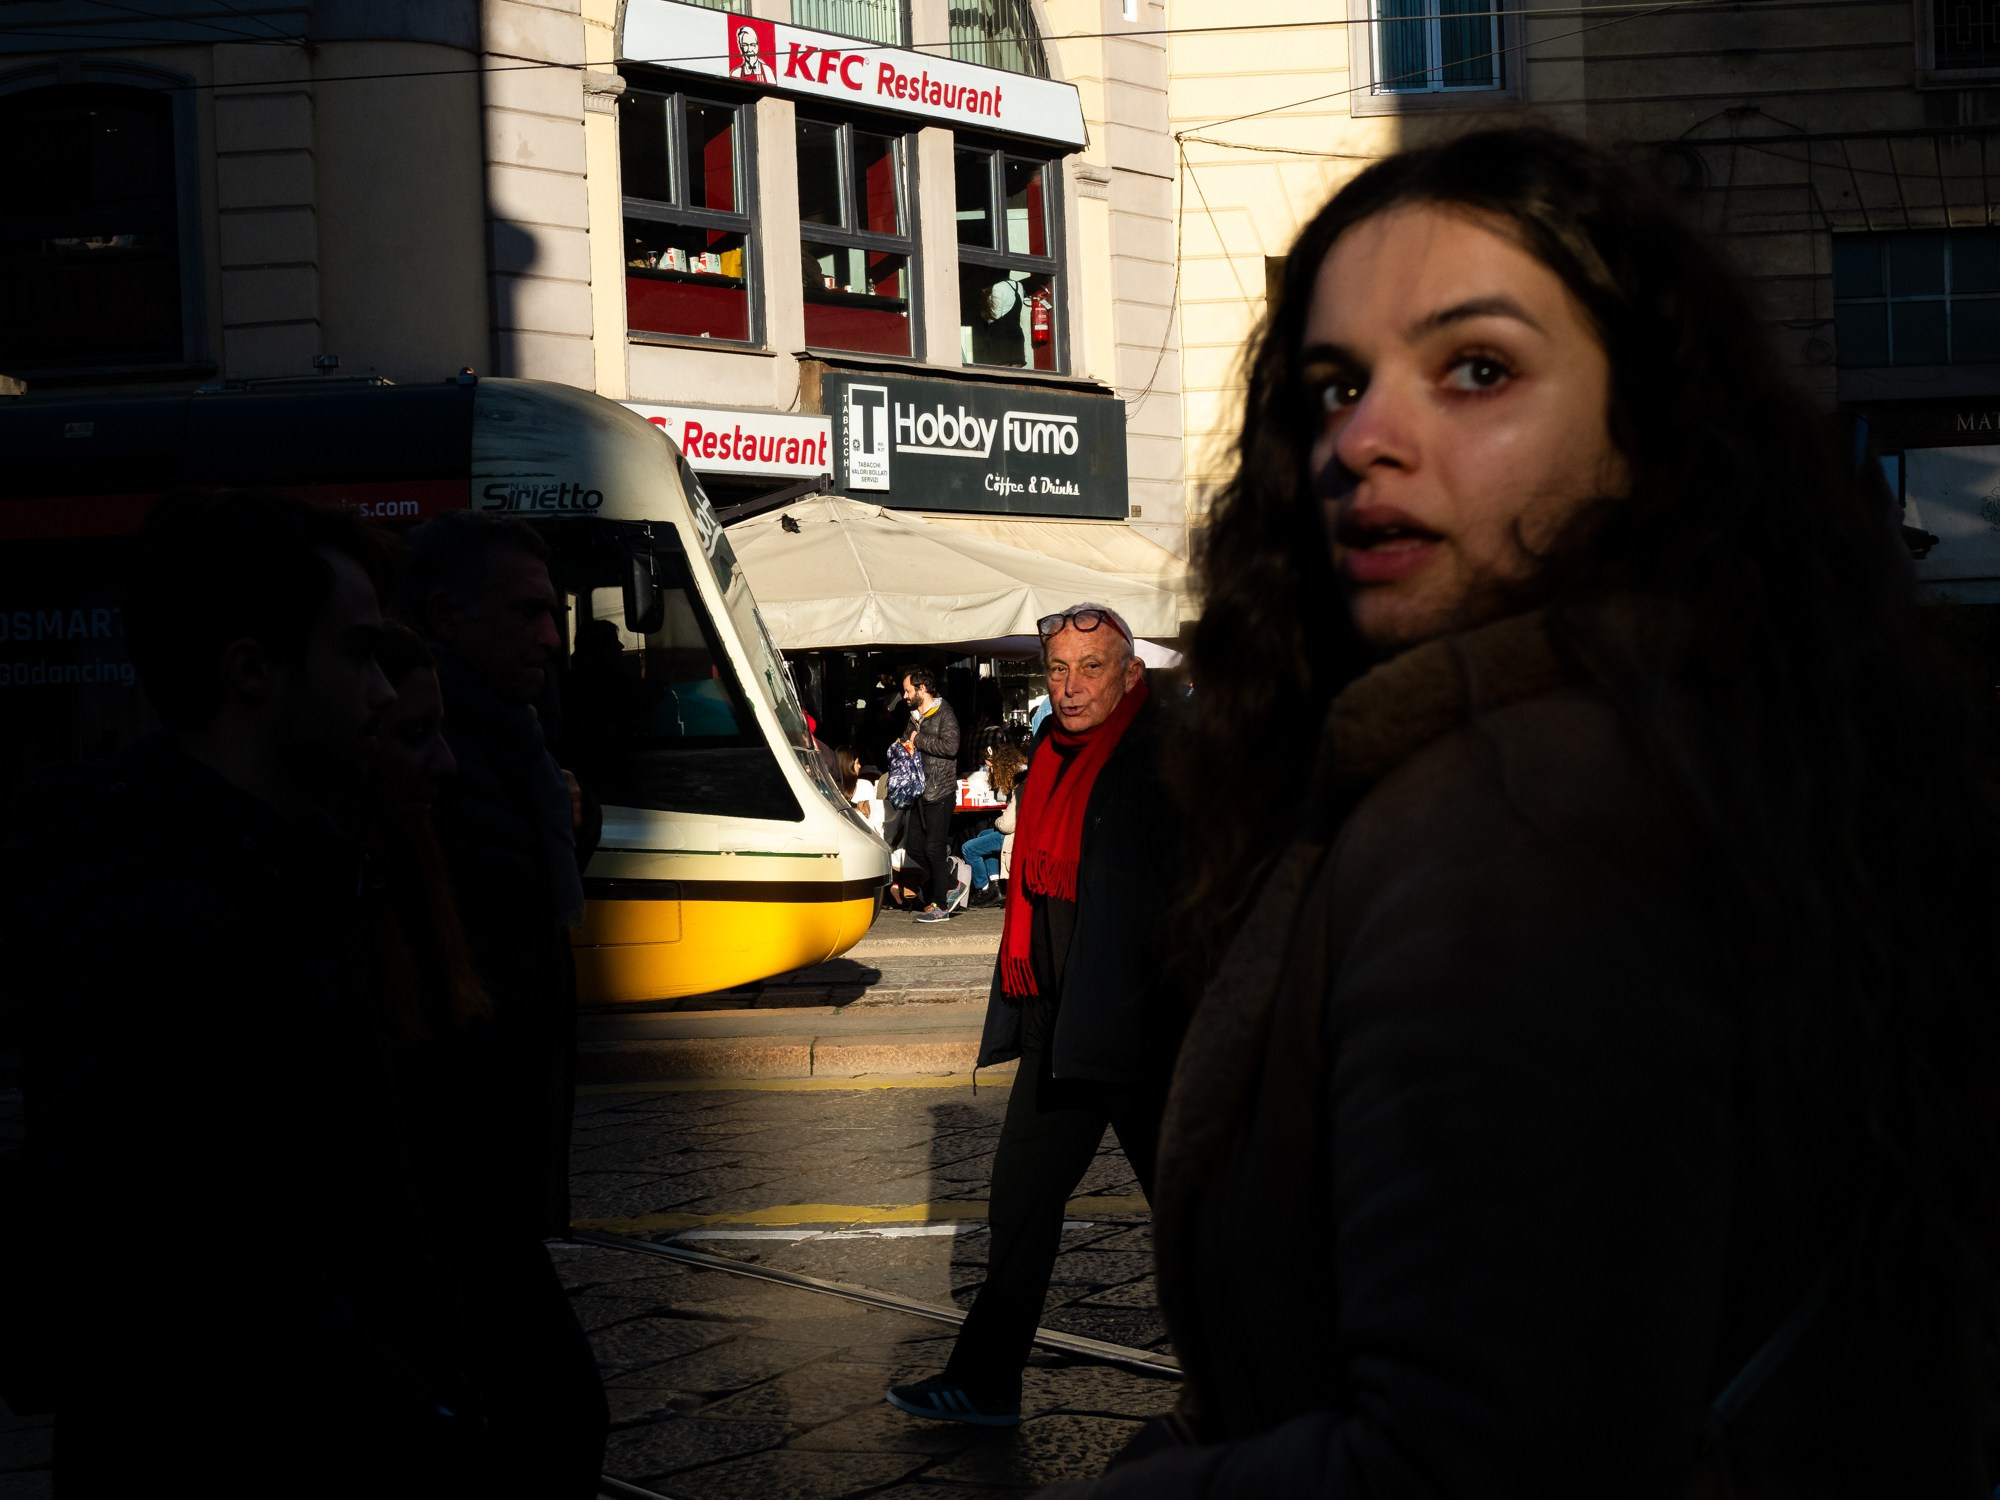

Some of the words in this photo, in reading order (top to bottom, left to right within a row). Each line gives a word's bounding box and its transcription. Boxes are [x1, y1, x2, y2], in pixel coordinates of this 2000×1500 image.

[784, 42, 865, 90] KFC
[877, 62, 1002, 118] Restaurant
[682, 421, 827, 466] Restaurant
[895, 402, 998, 458] Hobby
[1003, 411, 1079, 456] fumo
[985, 472, 1025, 496] Coffee
[1028, 476, 1038, 493] &
[1040, 477, 1080, 496] Drinks
